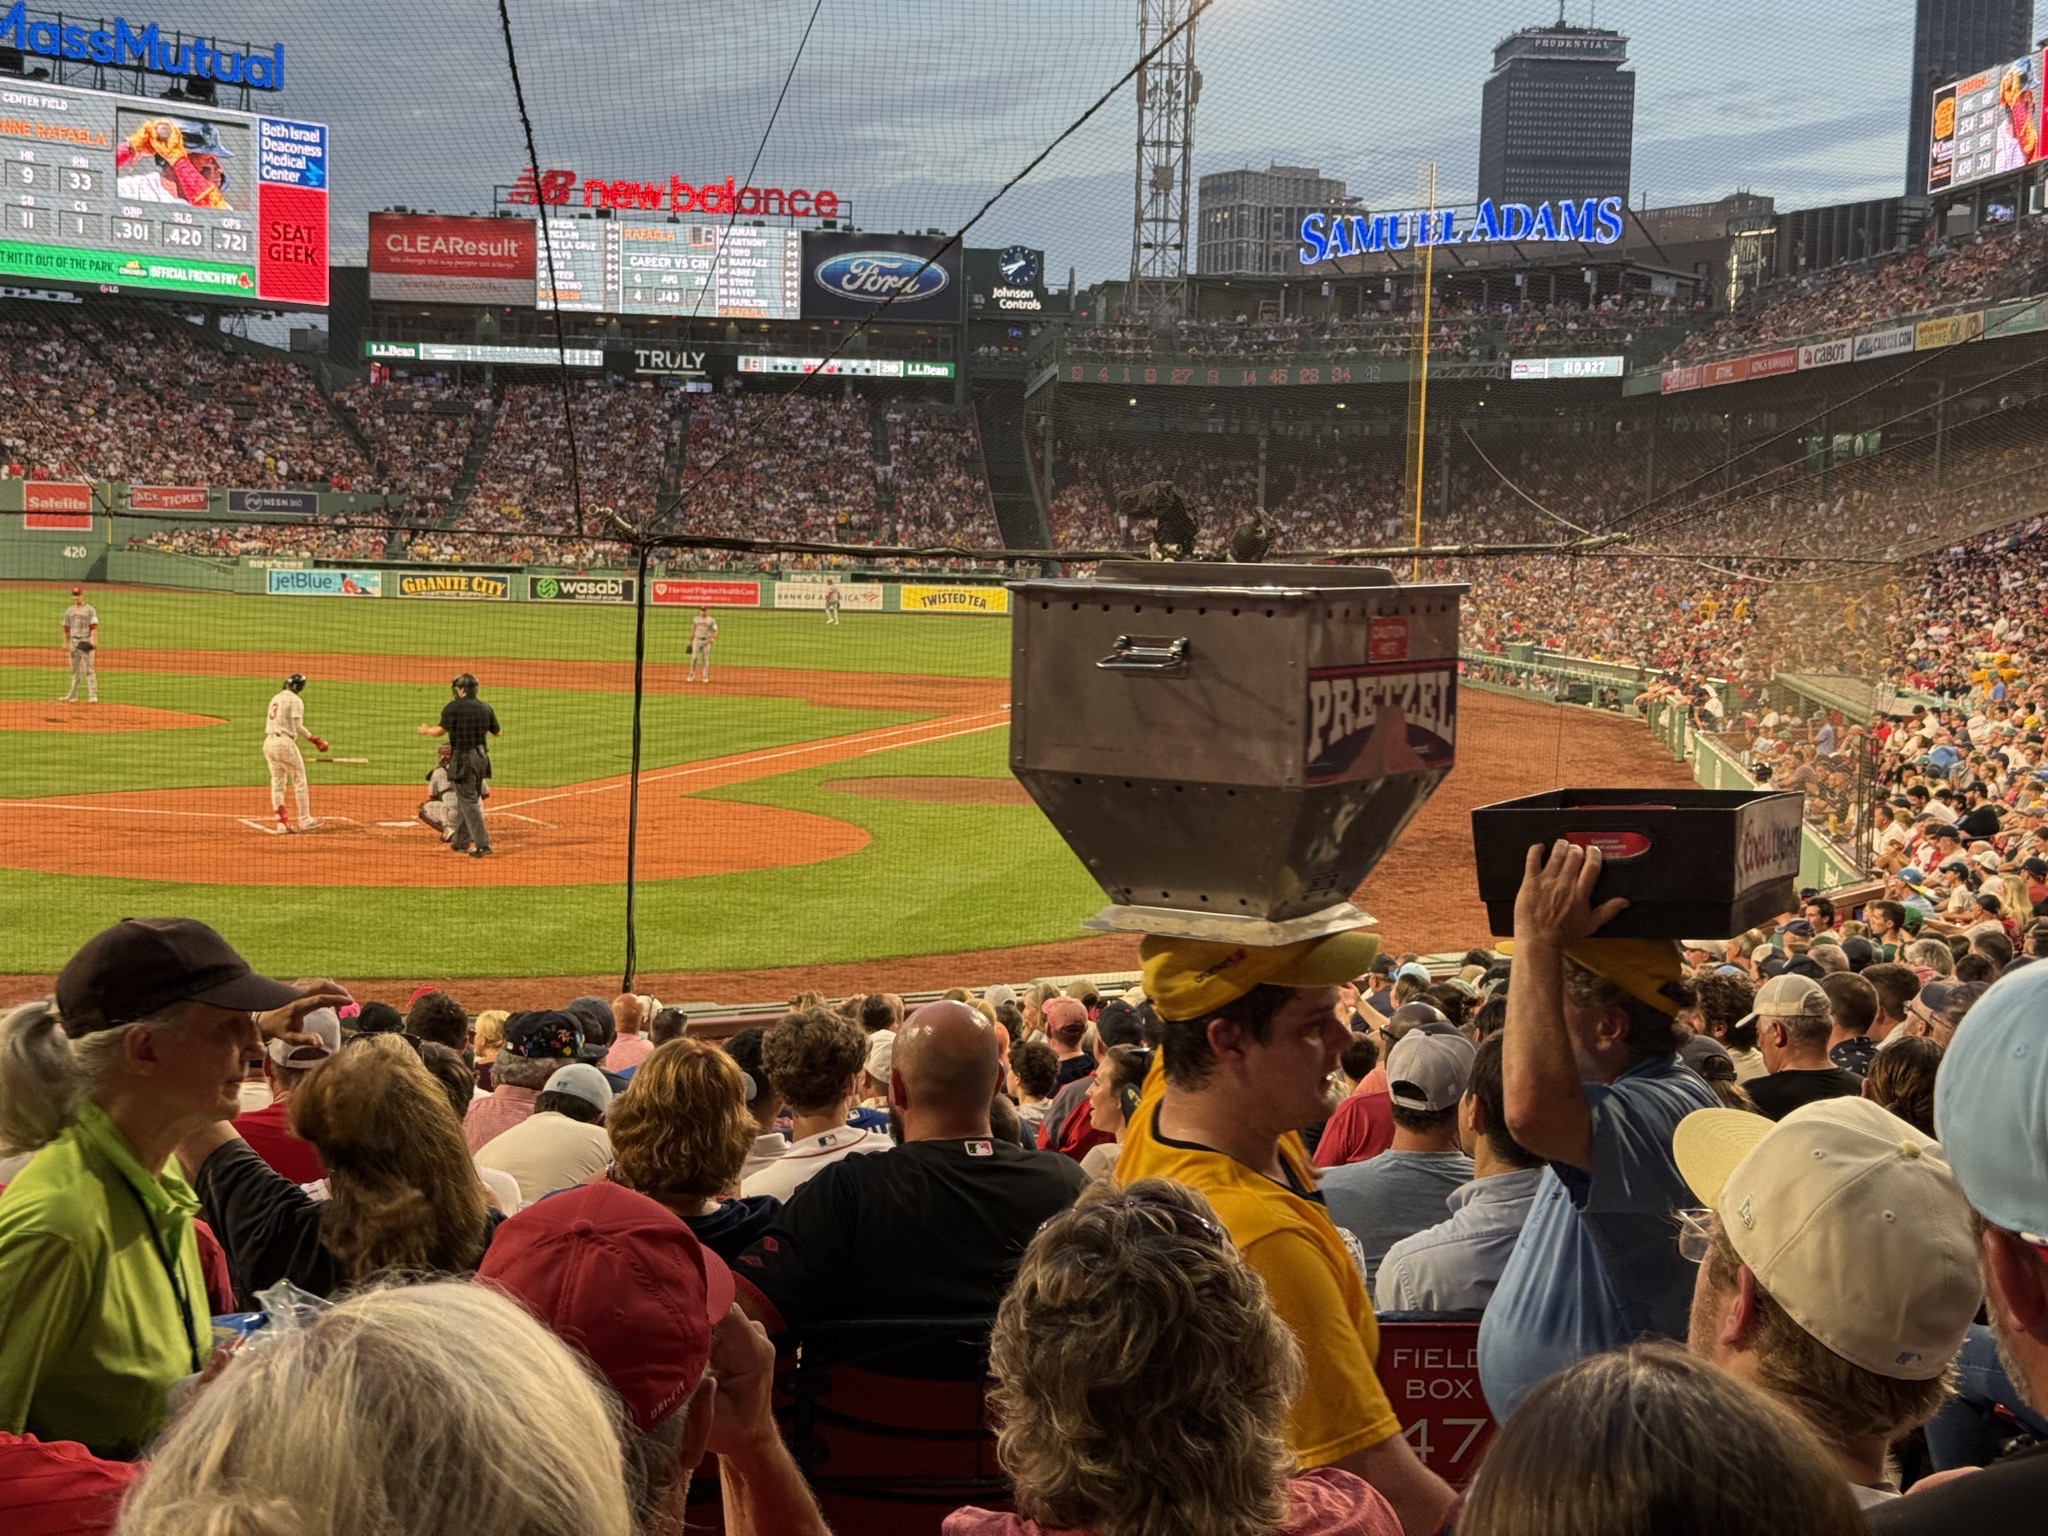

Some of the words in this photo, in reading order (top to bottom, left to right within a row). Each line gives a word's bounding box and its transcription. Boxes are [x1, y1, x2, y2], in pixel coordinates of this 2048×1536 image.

[1534, 38, 1610, 50] PRUDENTIAL
[3, 93, 40, 107] CENTER
[42, 98, 69, 111] FIELD
[35, 123, 107, 146] RAFAELA
[261, 121, 289, 139] Beth
[290, 125, 320, 143] Israel
[261, 137, 322, 157] Deaconess
[261, 152, 306, 170] Medical
[22, 166, 34, 184] 9
[69, 172, 92, 191] 33
[261, 166, 301, 184] Center
[583, 178, 665, 212] new
[670, 173, 839, 219] balance
[23, 211, 34, 229] 11
[122, 206, 143, 219] OBP
[173, 211, 193, 224] SLG
[78, 216, 84, 234] 1
[116, 222, 149, 242] .301
[222, 217, 241, 231] OPS
[269, 220, 317, 244] SEAT
[165, 227, 202, 246] .420
[216, 233, 247, 252] .721
[624, 227, 676, 241] RAFAELA
[729, 238, 768, 248] ANTHONY
[267, 243, 319, 266] GEEK
[385, 233, 519, 258] CLEAResult
[7, 252, 23, 264] HIT
[25, 253, 34, 265] IT
[36, 255, 54, 268] OUT
[56, 256, 68, 270] OF
[69, 257, 88, 271] THE
[89, 259, 115, 274] PARK
[629, 256, 672, 268] CAREER
[674, 257, 689, 269] VS
[691, 258, 710, 270] CIN
[150, 265, 187, 281] OFFICIAL
[221, 271, 238, 286] FRY
[729, 278, 755, 287] STORY
[841, 257, 922, 293] Ford
[633, 290, 642, 302] 4
[657, 291, 680, 303] .143
[992, 287, 1034, 300] Johnson
[999, 299, 1042, 311] Controls
[635, 350, 706, 370] TRULY
[881, 364, 898, 375] 2ND
[1097, 367, 1109, 381] 4
[1123, 367, 1131, 383] 1
[1170, 368, 1194, 384] 27
[1267, 368, 1288, 385] 45
[1330, 366, 1350, 383] 34
[1363, 366, 1381, 382] 42
[28, 496, 88, 510] Safelite
[162, 492, 207, 507] TICKET
[263, 499, 288, 507] NESN
[63, 546, 87, 559] 420
[275, 572, 333, 591] jetBlue
[401, 576, 469, 595] GRANITE
[471, 575, 507, 597] CITY
[560, 579, 623, 596] wasabi
[777, 593, 802, 601] BANK
[920, 592, 967, 608] TWISTED
[968, 594, 987, 610] TEA
[1379, 641, 1399, 655] HOT
[269, 702, 279, 720] 3
[1393, 1348, 1478, 1369] FIELD
[1405, 1378, 1474, 1400] BOX
[1401, 1417, 1488, 1464] 47
